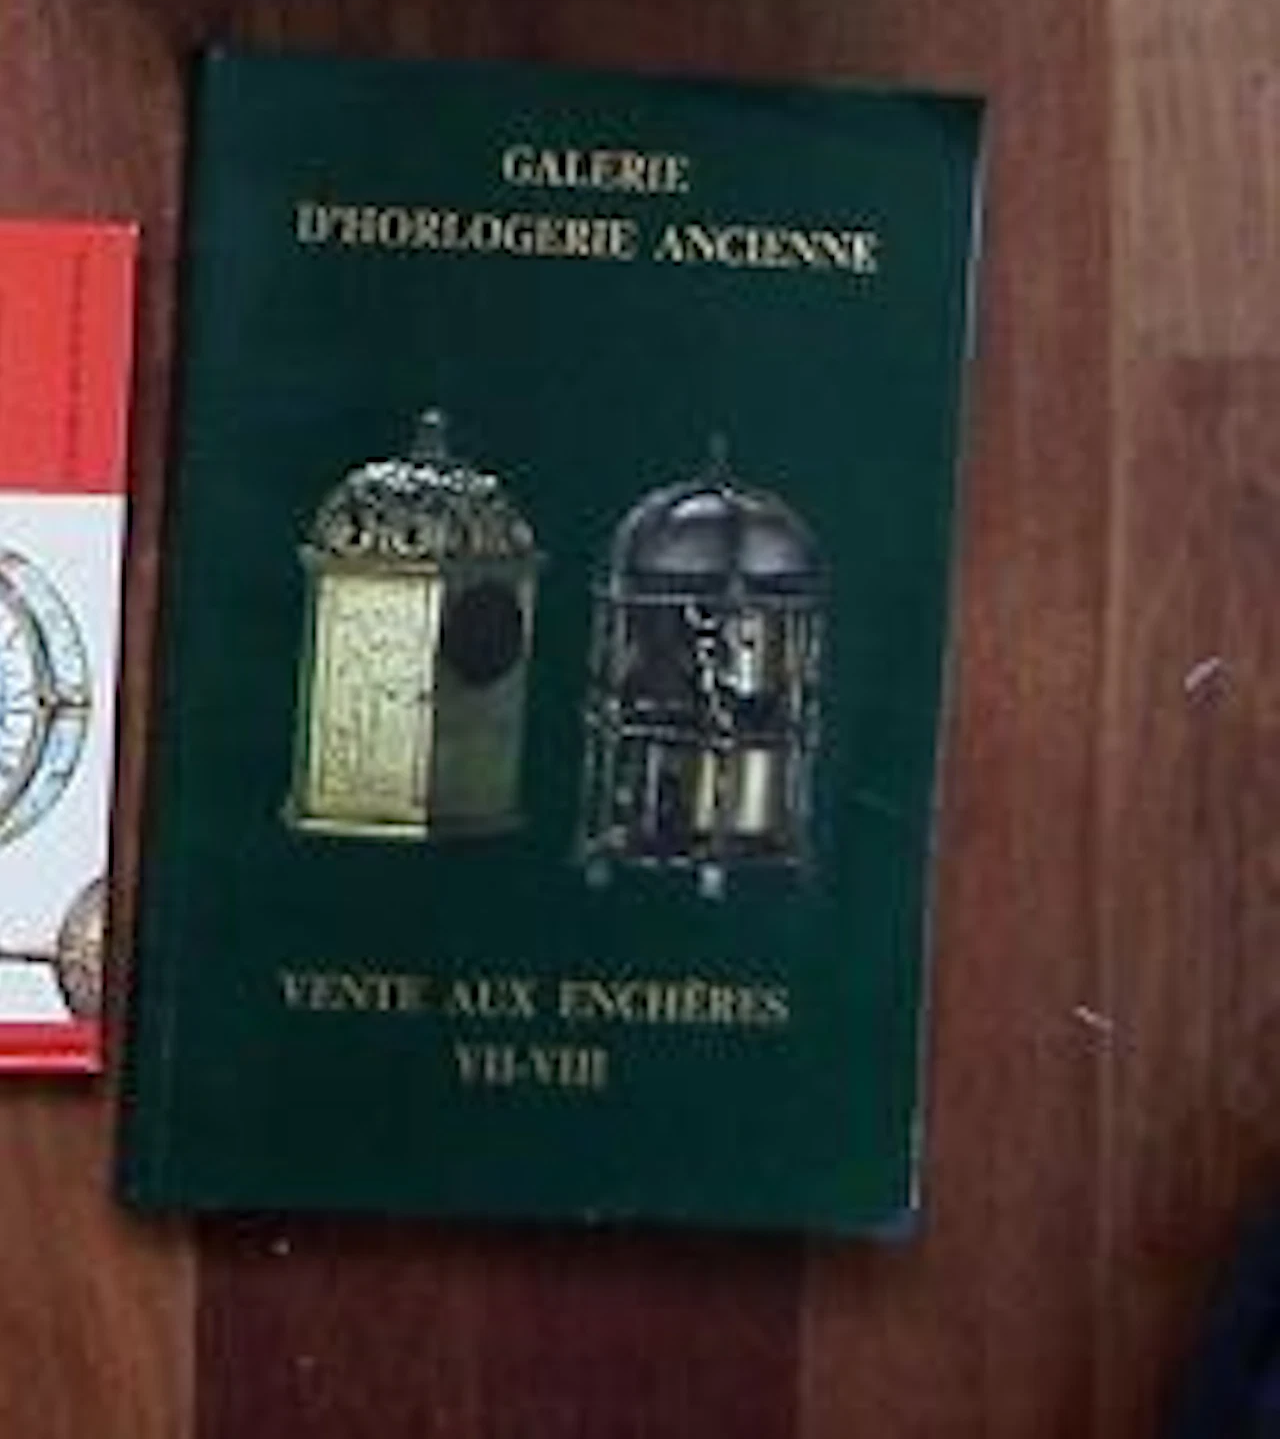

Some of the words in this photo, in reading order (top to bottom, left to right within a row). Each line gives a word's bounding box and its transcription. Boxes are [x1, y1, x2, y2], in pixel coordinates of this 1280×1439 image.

[502, 143, 690, 194] GALERIE
[295, 201, 637, 260] D'HORLOGERIE
[653, 221, 879, 274] ANCIENNE
[281, 972, 433, 1013] VENTE
[448, 978, 539, 1018] AUX
